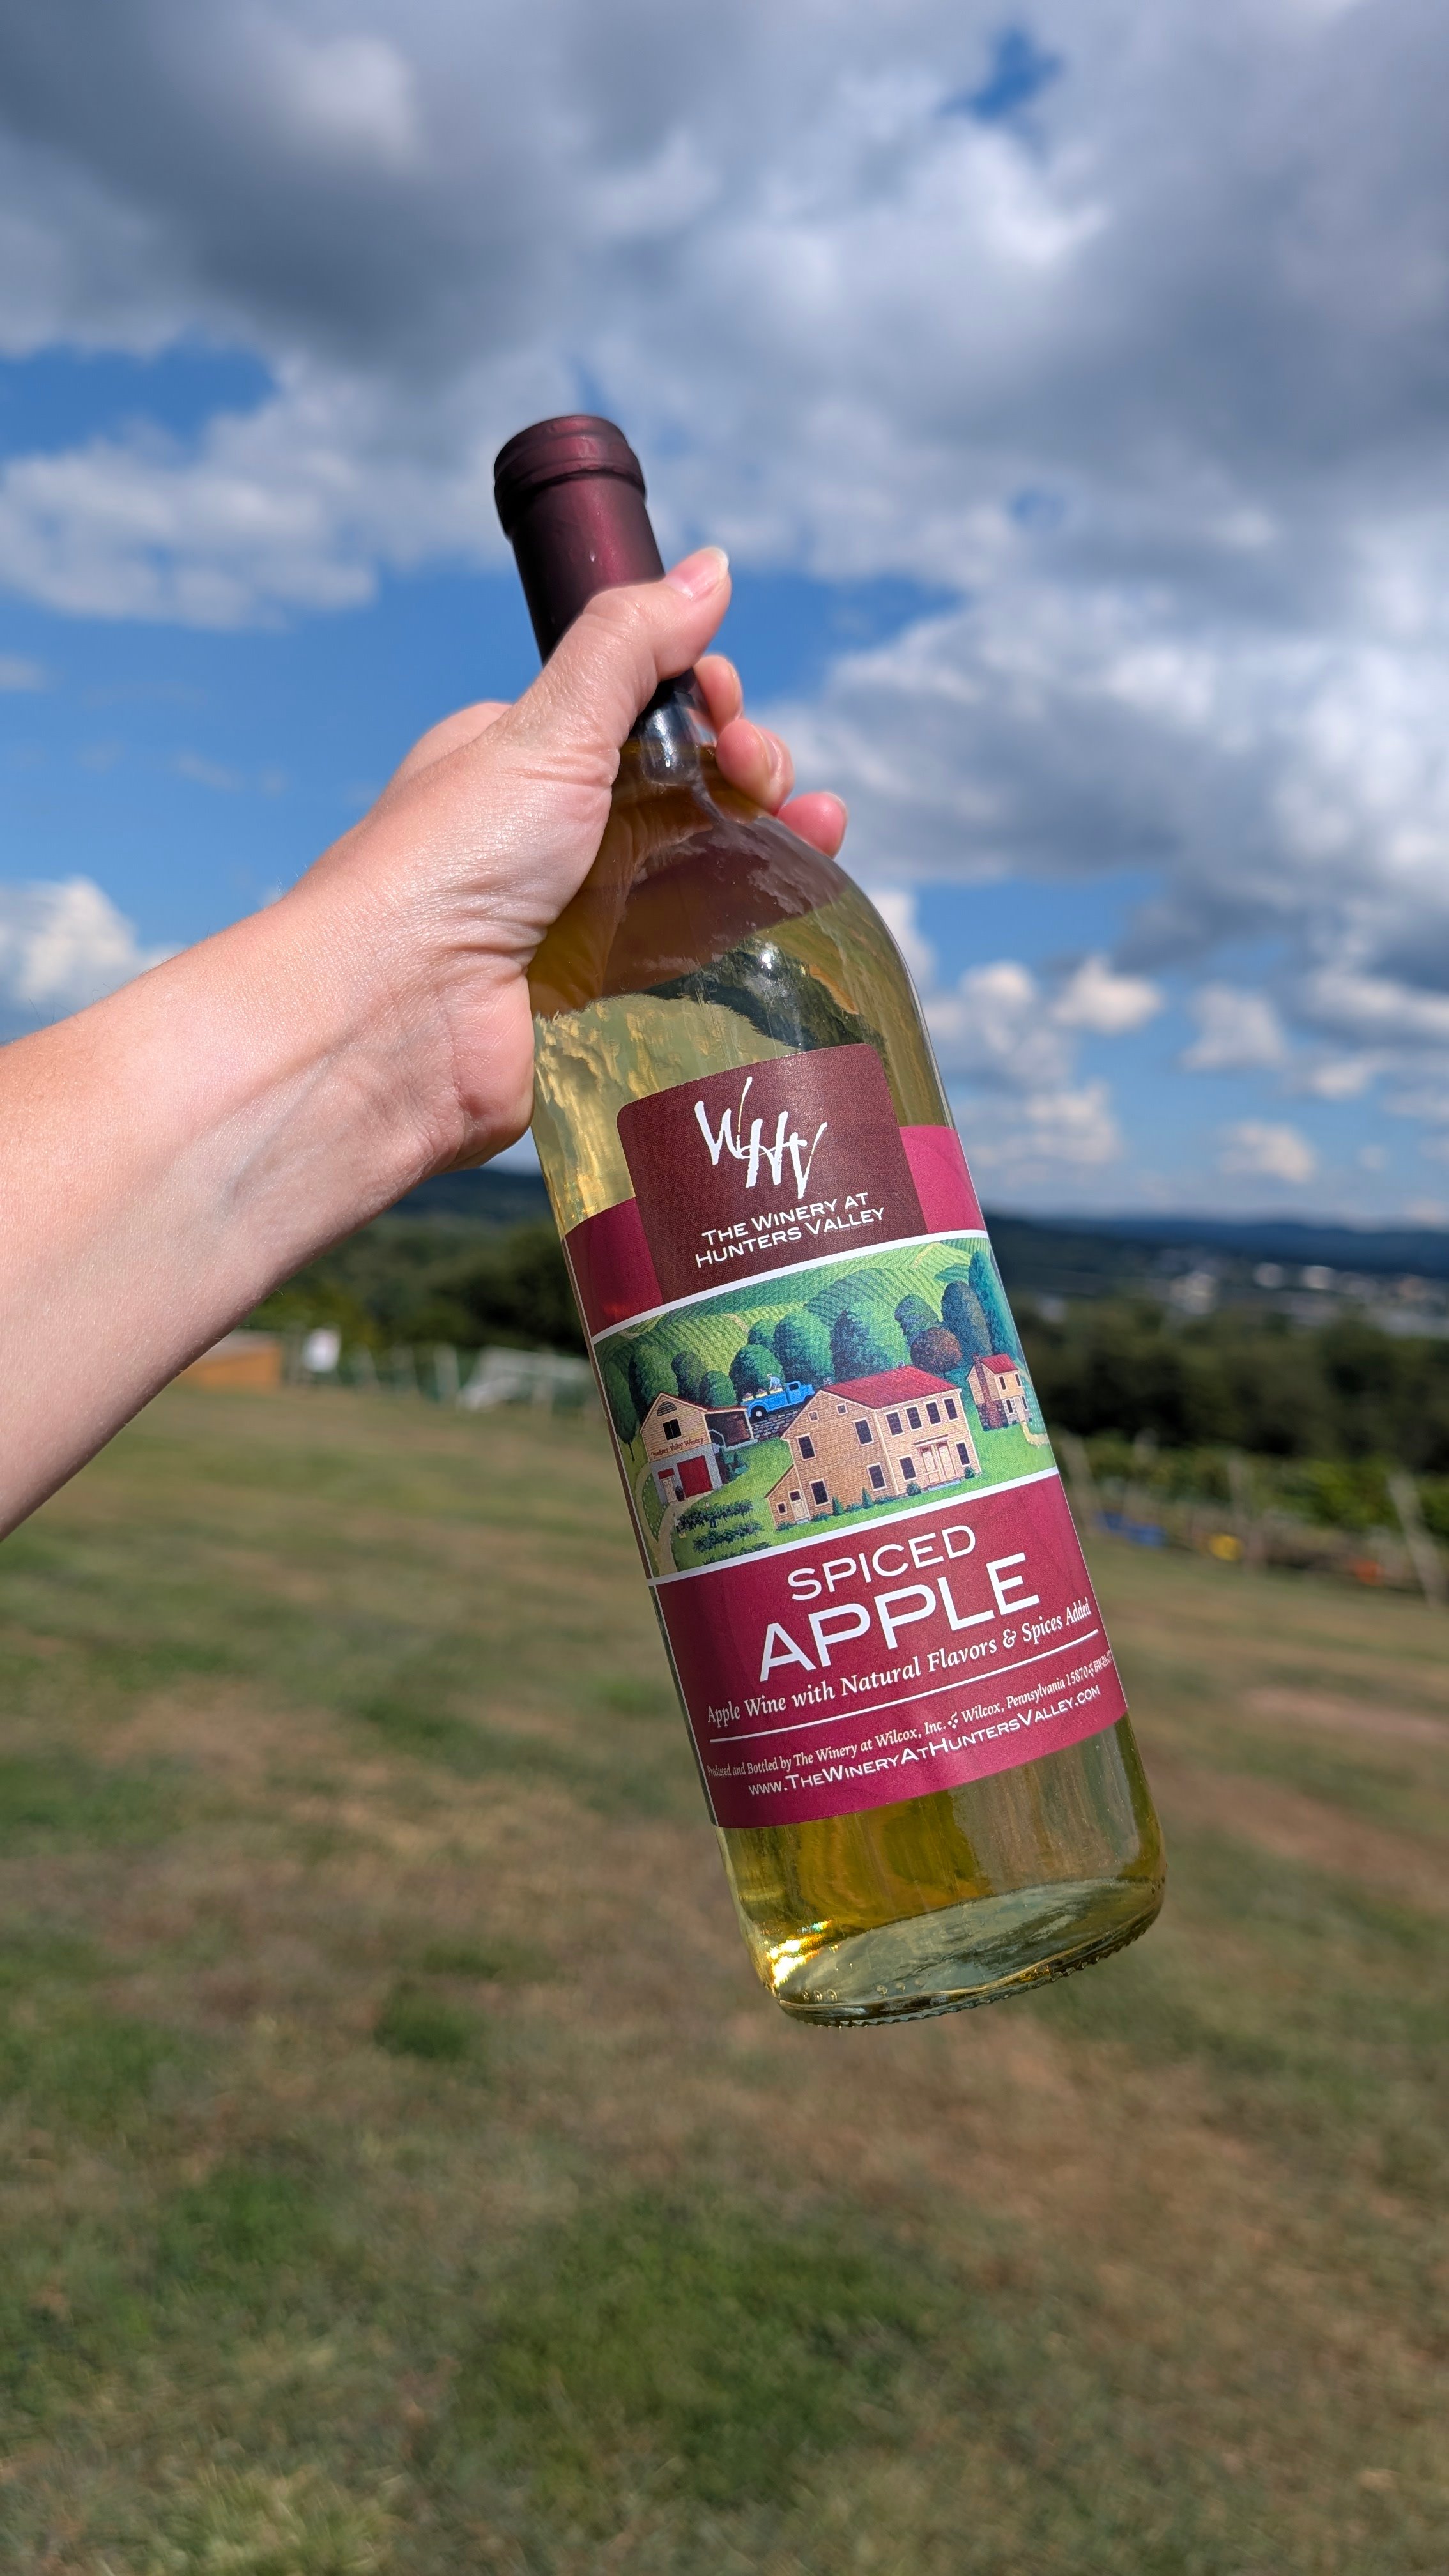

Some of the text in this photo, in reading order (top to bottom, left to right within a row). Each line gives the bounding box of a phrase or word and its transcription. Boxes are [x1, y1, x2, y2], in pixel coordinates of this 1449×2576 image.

[845, 1192, 868, 1209] AT
[759, 1552, 1040, 1682] APPLE
[786, 1524, 976, 1601] SPICED
[707, 1596, 1091, 1728] Apple Wine with Natural Flavors & Spices Added
[707, 1763, 732, 1777] Produced
[733, 1762, 746, 1775] and
[747, 1757, 779, 1774] Bottled
[779, 1756, 792, 1772] by
[793, 1752, 814, 1767] The
[815, 1744, 857, 1763] Winery
[861, 1738, 873, 1752] at
[874, 1728, 922, 1747] Wilcox,
[924, 1721, 947, 1735] Inc.
[961, 1702, 1005, 1722] Wilcox,
[1006, 1677, 1066, 1709] Pennsylvania
[1066, 1665, 1089, 1686] 15870
